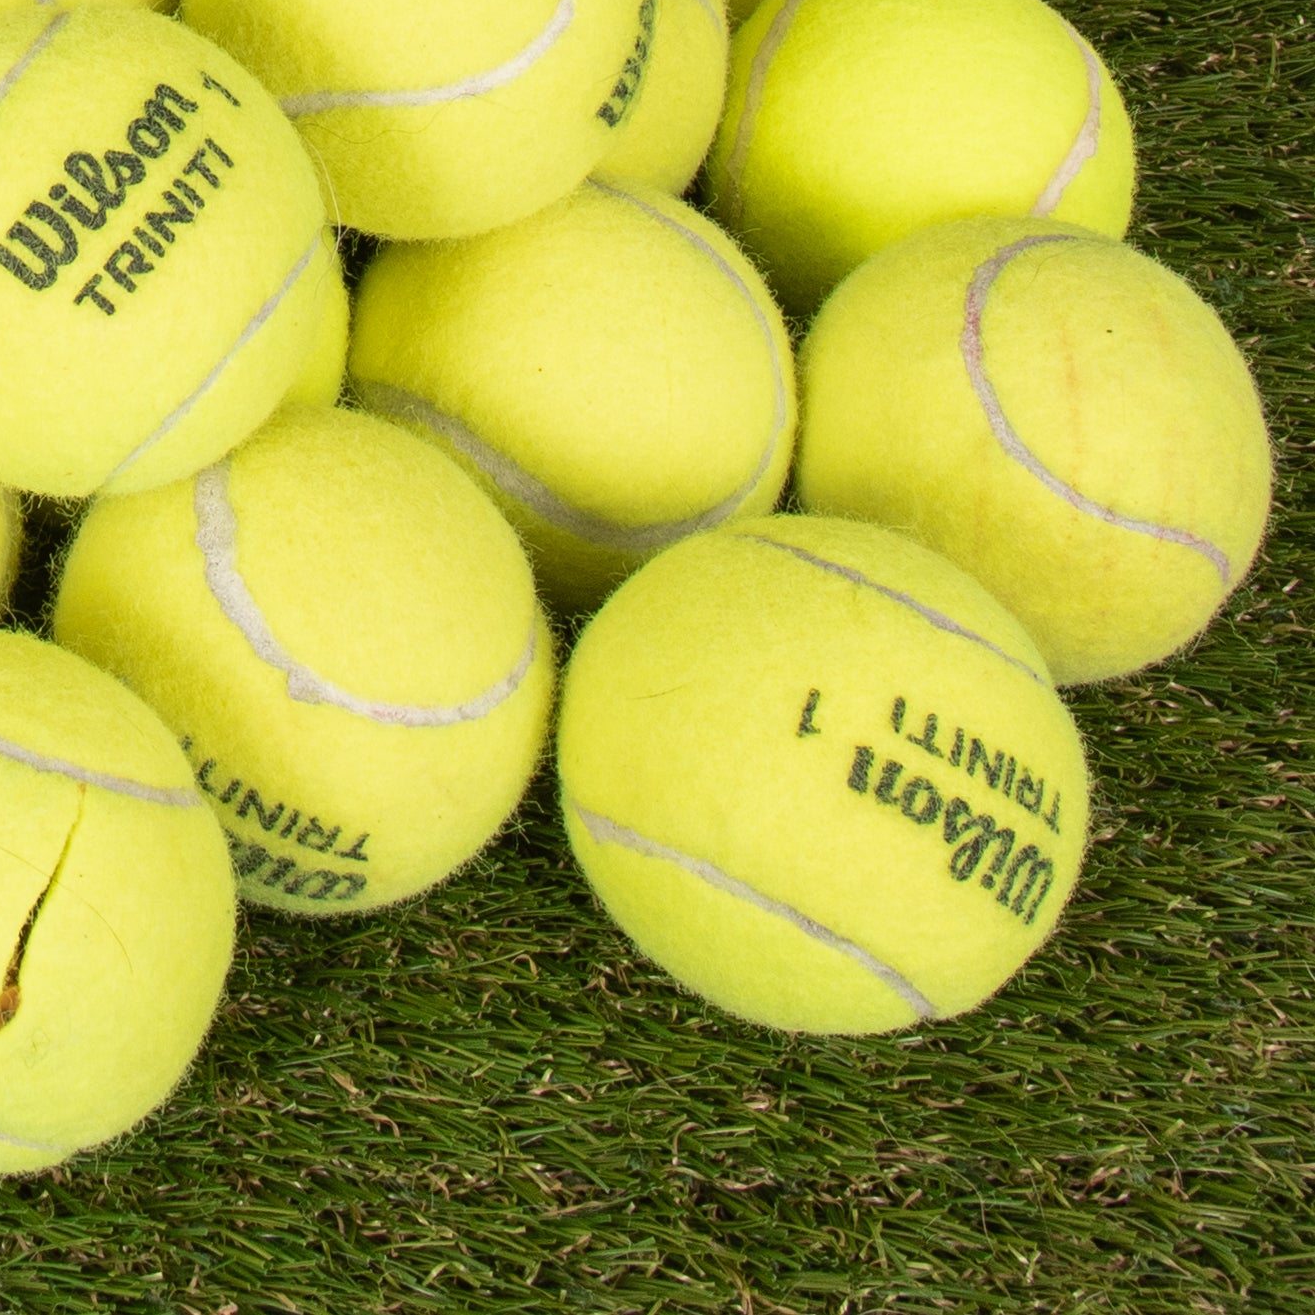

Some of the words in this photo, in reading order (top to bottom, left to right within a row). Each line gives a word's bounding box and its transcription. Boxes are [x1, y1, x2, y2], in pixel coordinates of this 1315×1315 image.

[200, 71, 242, 108] 1
[72, 136, 236, 317] TRINITI
[795, 688, 822, 738] 1
[891, 696, 1062, 835] TRINITI
[847, 745, 1054, 926] Wilson
